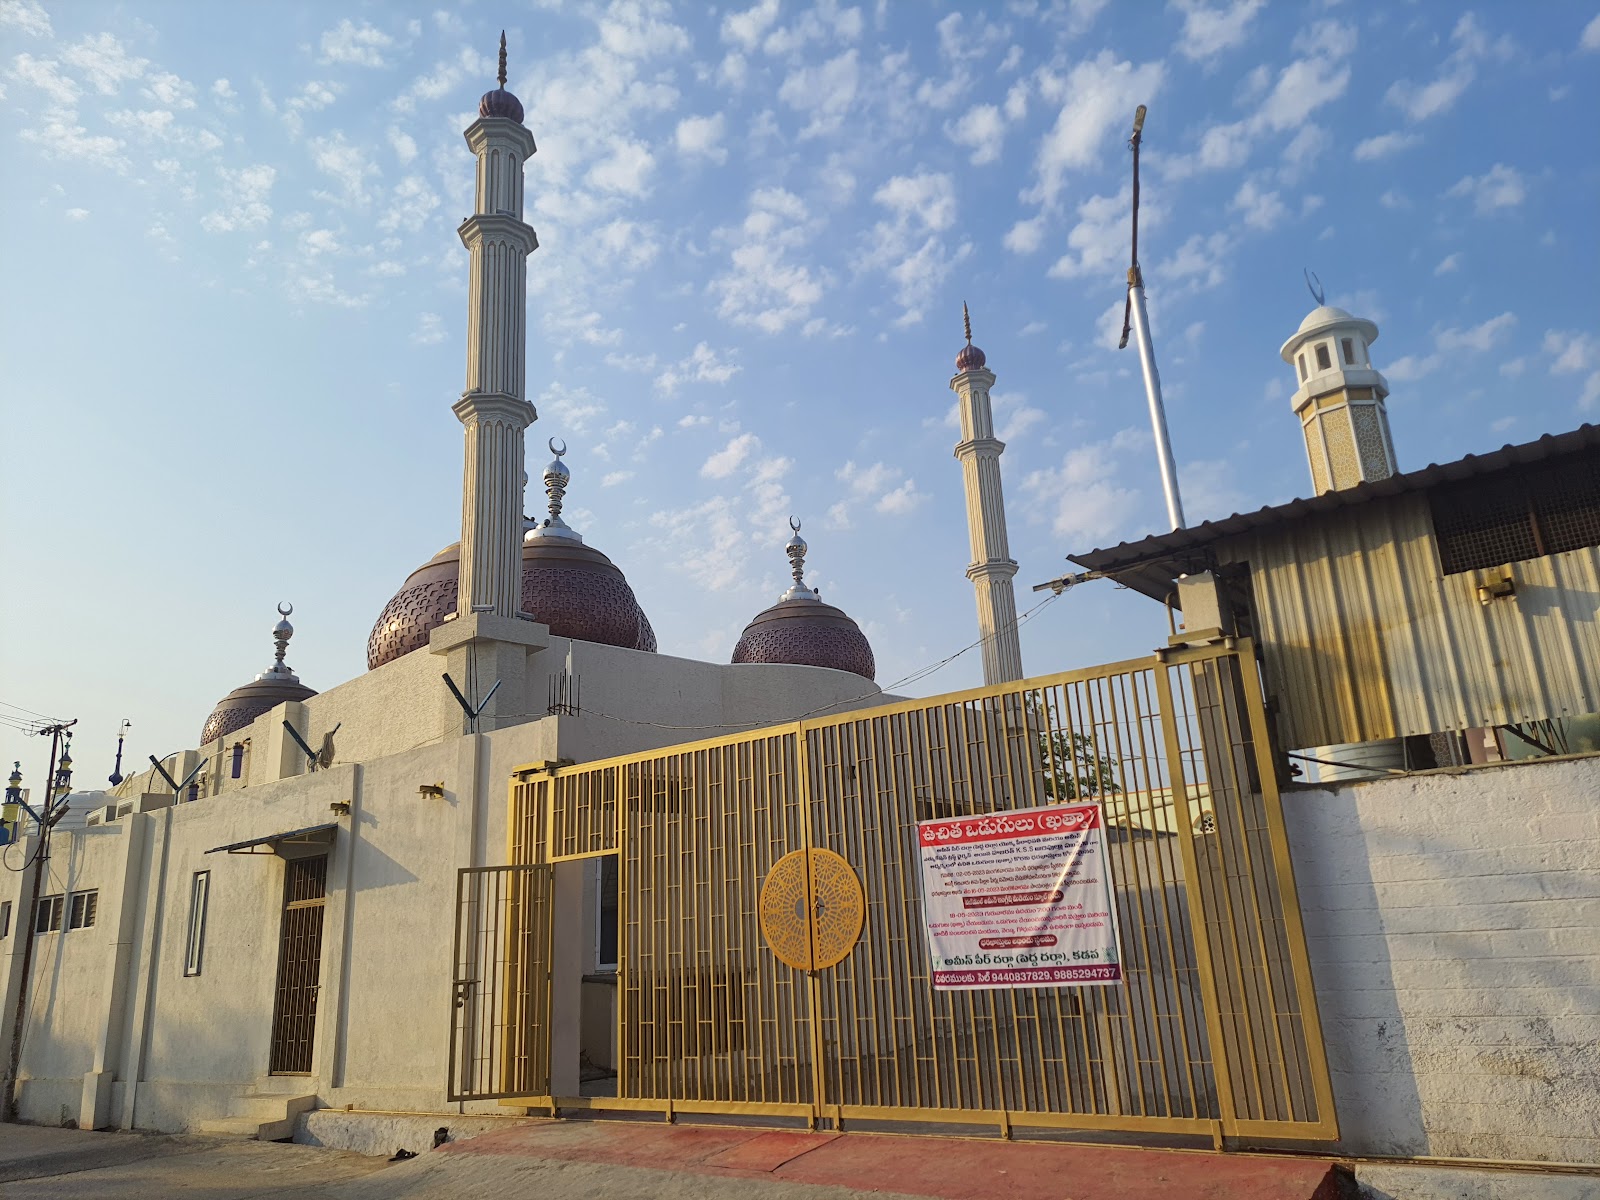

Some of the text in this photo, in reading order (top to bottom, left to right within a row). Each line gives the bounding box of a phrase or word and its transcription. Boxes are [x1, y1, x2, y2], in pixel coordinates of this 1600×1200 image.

[923, 822, 963, 841] ఉచిత
[965, 816, 1035, 838] ఒడుగులు
[944, 954, 973, 966] అమీన్
[975, 953, 991, 965] పీర్
[993, 955, 1014, 968] దర్గా
[1072, 949, 1099, 960] కడప
[991, 971, 1053, 982] 9440837829,
[1054, 968, 1116, 980] 9885294737
